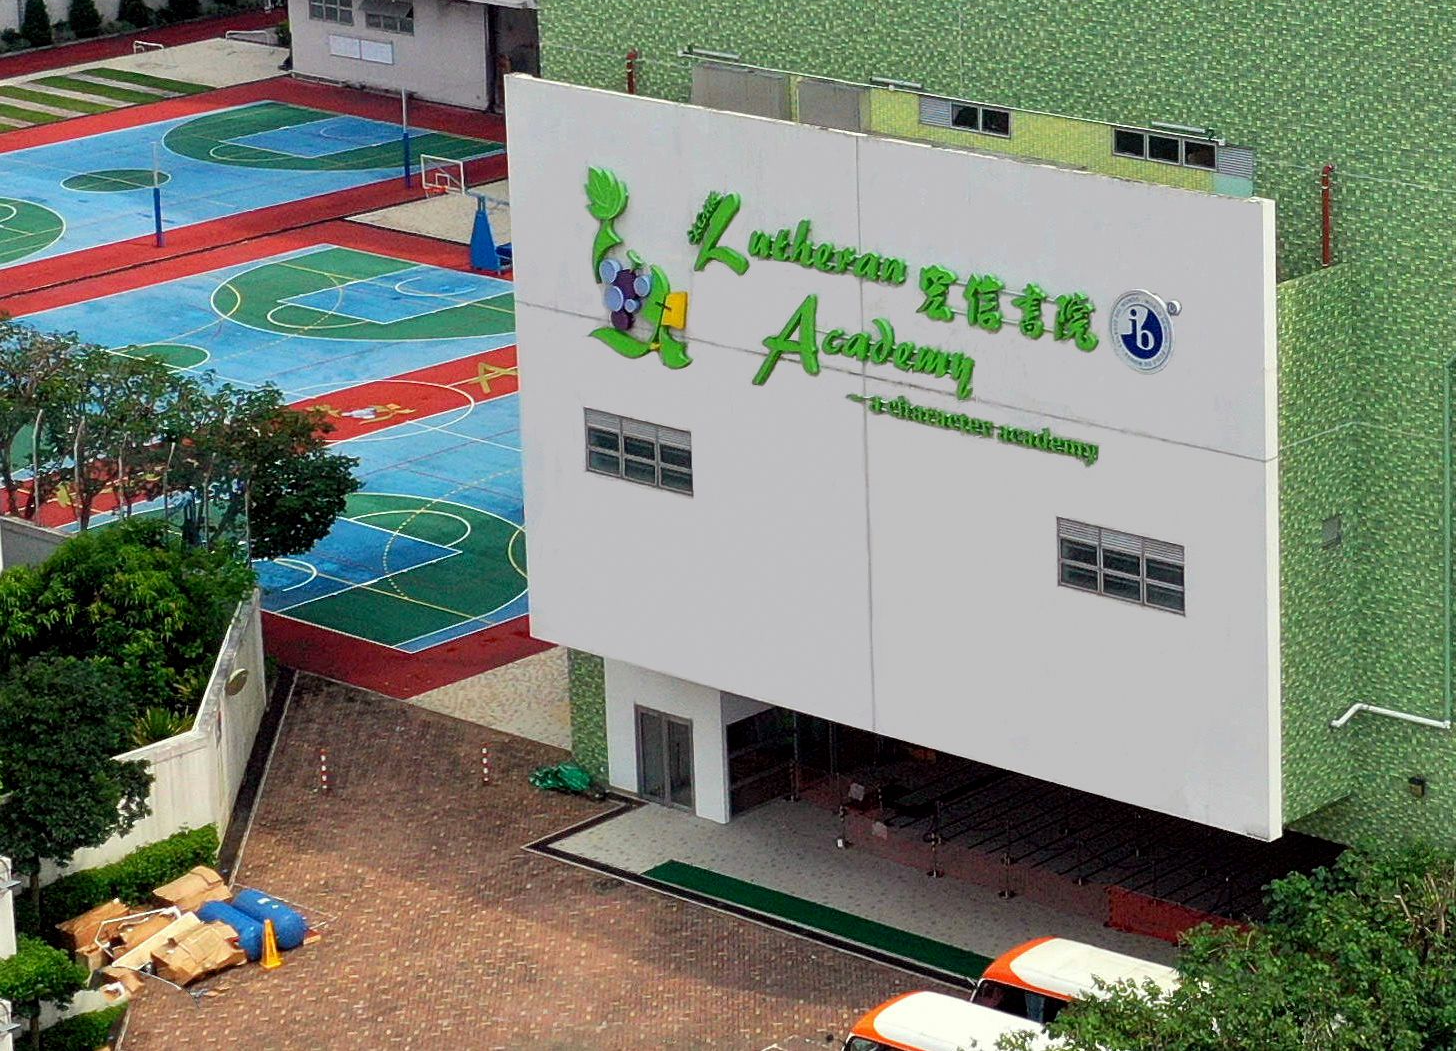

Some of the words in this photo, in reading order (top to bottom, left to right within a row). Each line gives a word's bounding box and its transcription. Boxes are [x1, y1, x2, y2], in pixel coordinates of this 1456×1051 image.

[687, 191, 909, 286] Lutheran
[751, 293, 976, 400] Academy
[916, 265, 1099, 352] 宏信書院
[887, 395, 994, 438] character
[997, 425, 1099, 468] academy
